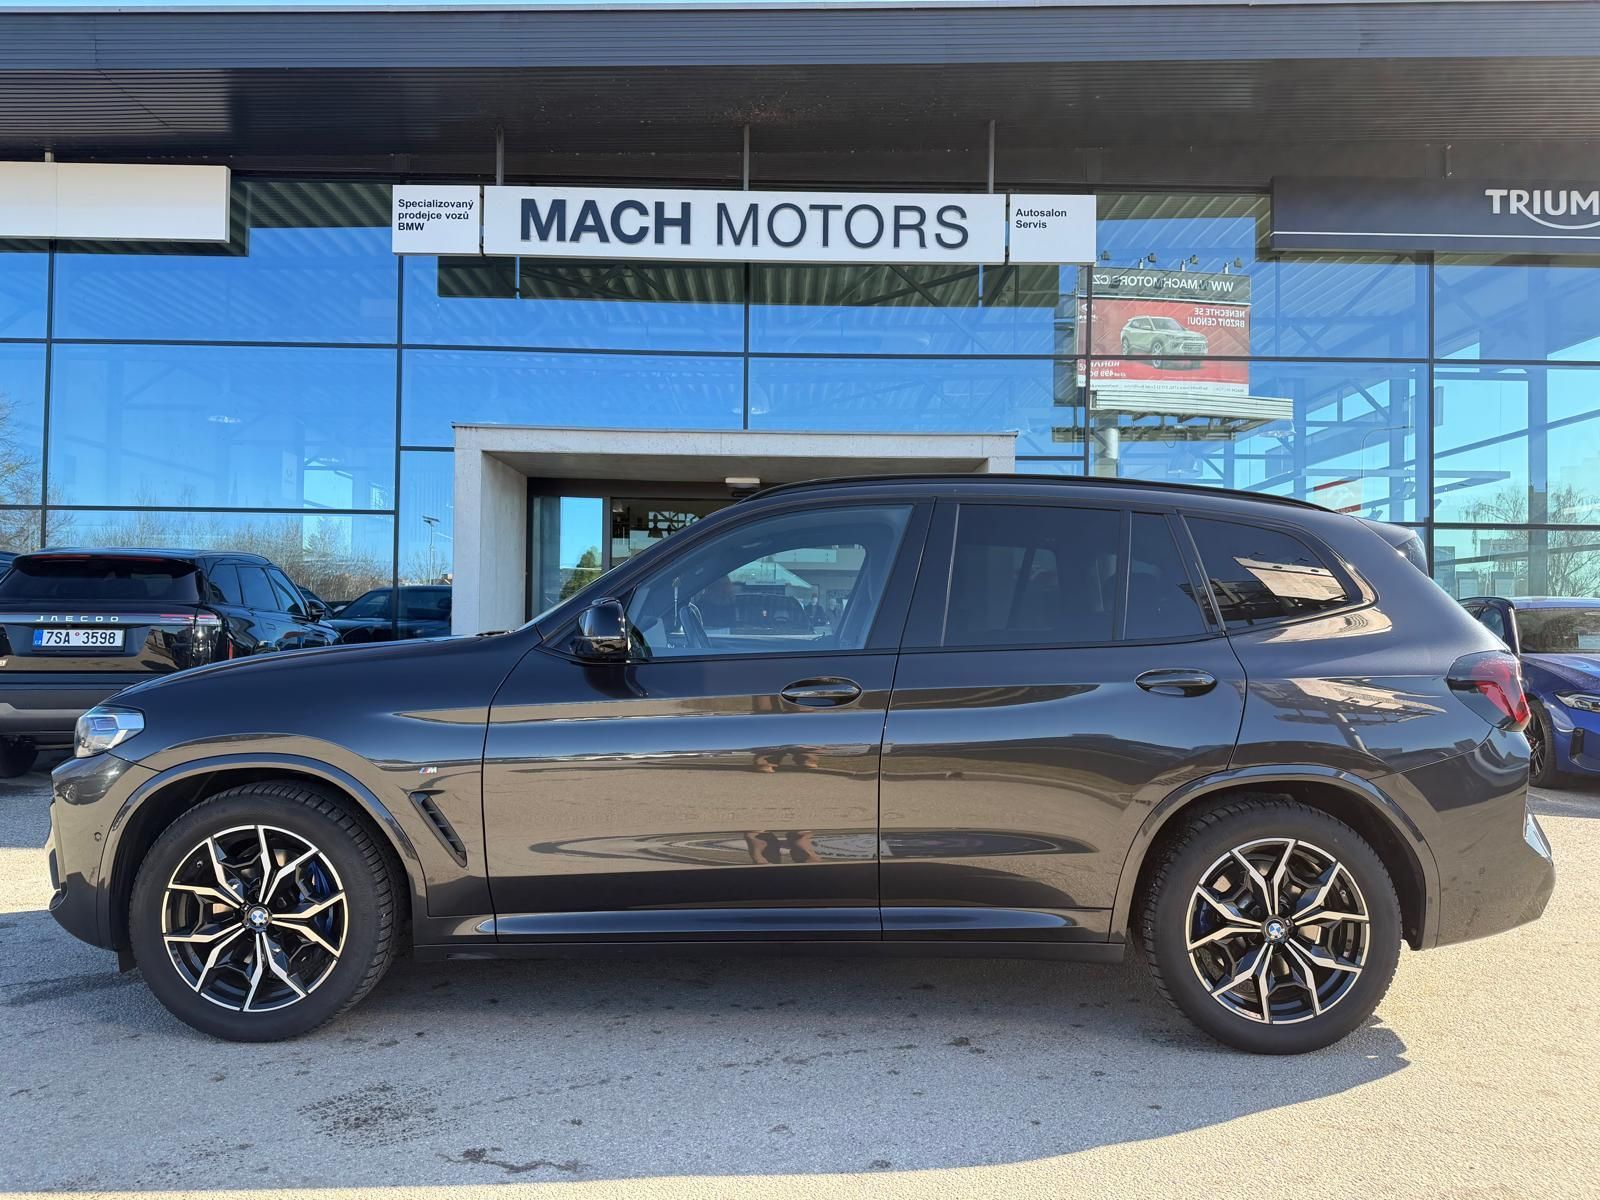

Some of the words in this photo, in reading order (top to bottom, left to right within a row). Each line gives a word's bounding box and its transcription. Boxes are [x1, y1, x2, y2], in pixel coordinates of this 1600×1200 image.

[398, 198, 474, 210] Specializovaný
[398, 210, 443, 221] prodejce
[444, 210, 469, 220] vozů
[1015, 208, 1067, 218] Autosalon
[398, 222, 425, 231] BMW
[520, 198, 691, 245] MACH
[716, 202, 969, 249] MOTORS
[1015, 219, 1047, 229] Servis
[45, 631, 71, 645] 7SA
[81, 631, 116, 645] 3598
